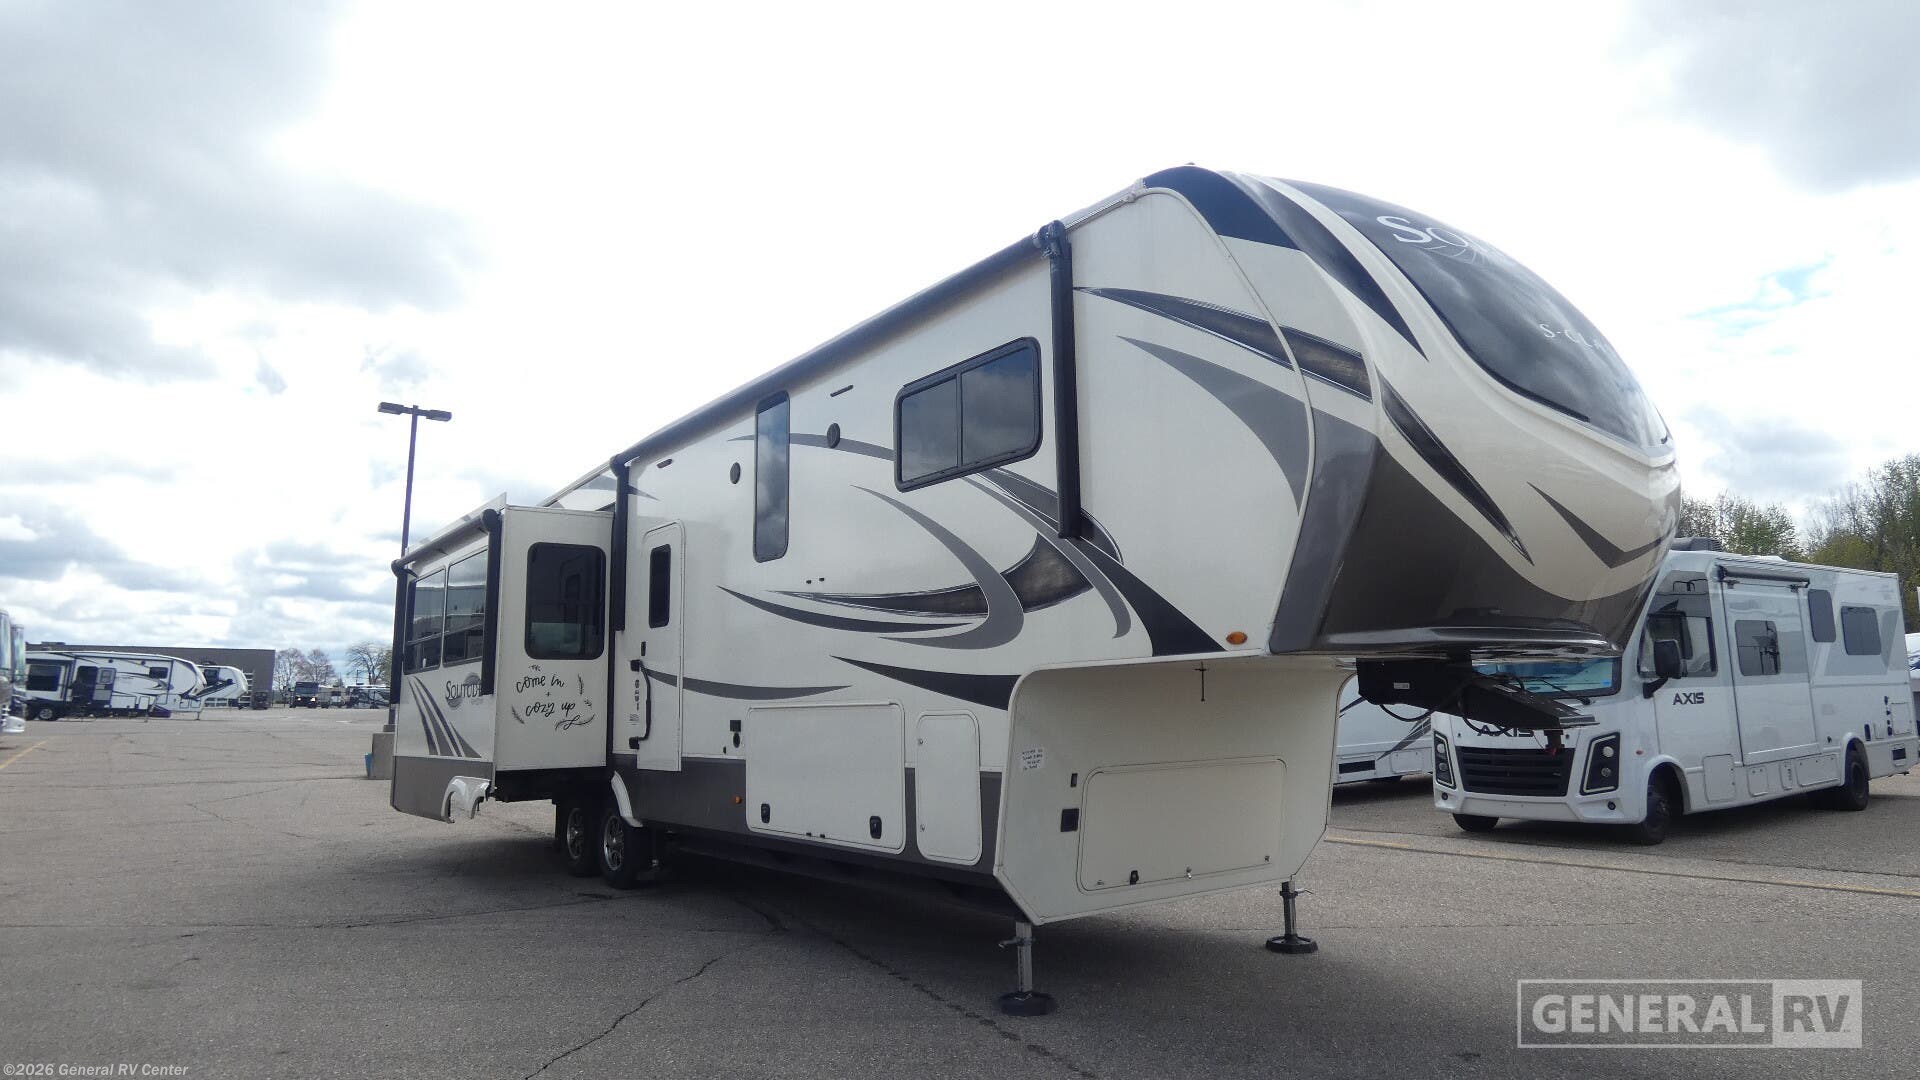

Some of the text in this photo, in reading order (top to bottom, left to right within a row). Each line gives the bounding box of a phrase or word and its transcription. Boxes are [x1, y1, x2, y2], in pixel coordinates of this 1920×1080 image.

[445, 680, 482, 700] SOLITUD
[516, 673, 565, 693] come in
[1672, 691, 1705, 706] AXIS
[525, 701, 576, 718] cozy up
